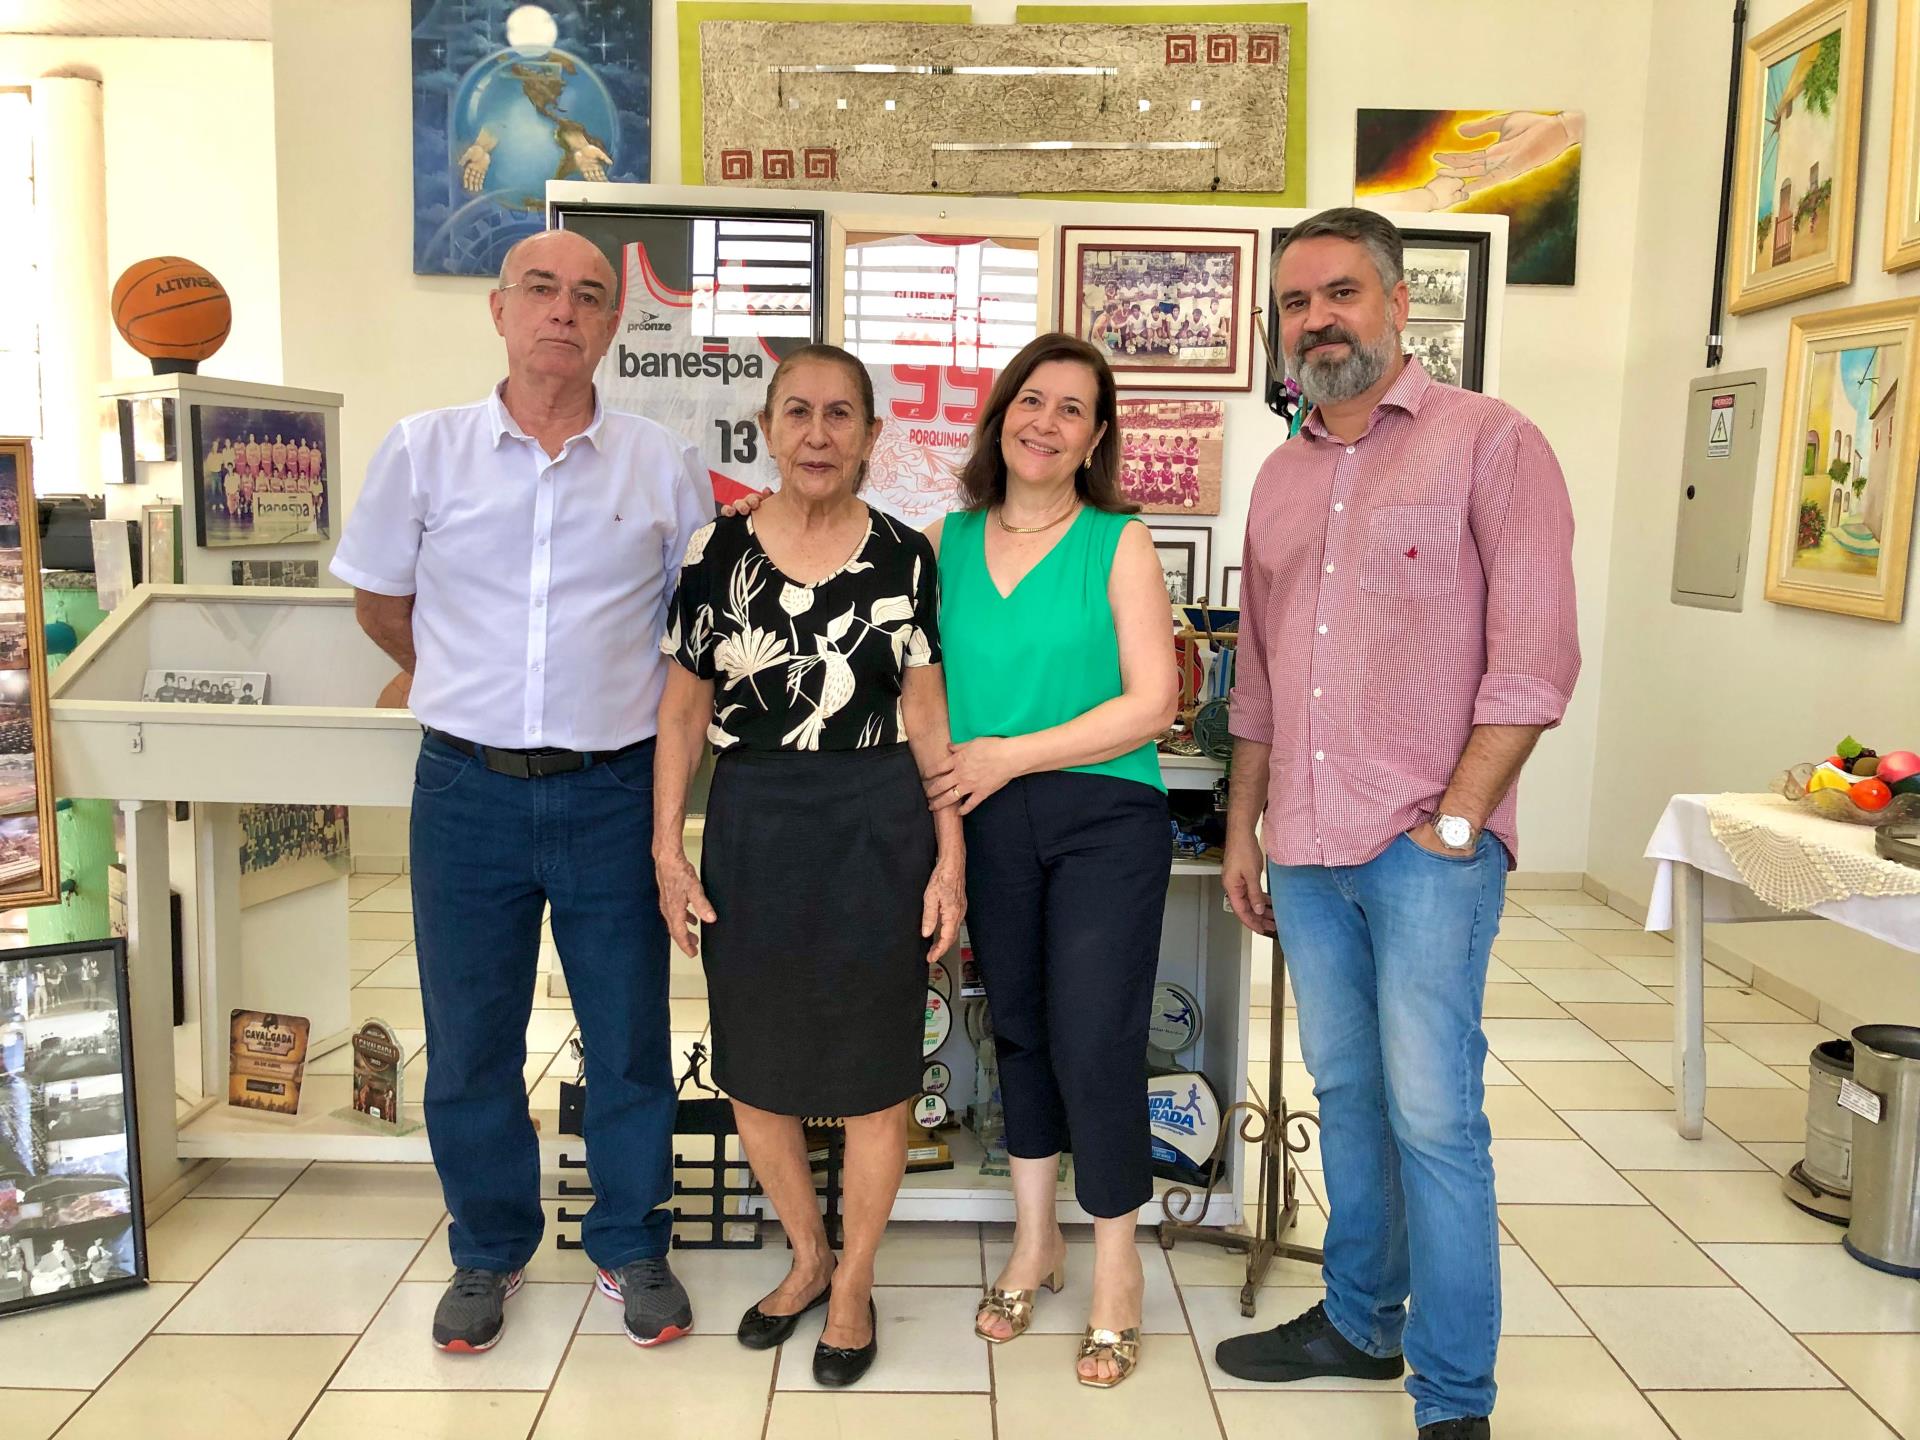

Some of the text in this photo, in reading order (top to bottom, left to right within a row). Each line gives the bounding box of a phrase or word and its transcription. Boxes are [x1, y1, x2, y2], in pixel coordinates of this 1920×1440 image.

[156, 277, 218, 296] PENALTY
[619, 344, 763, 385] banespa
[715, 419, 757, 464] 13
[909, 428, 969, 448] PORQUINHO
[245, 1029, 292, 1044] CAVALGADA
